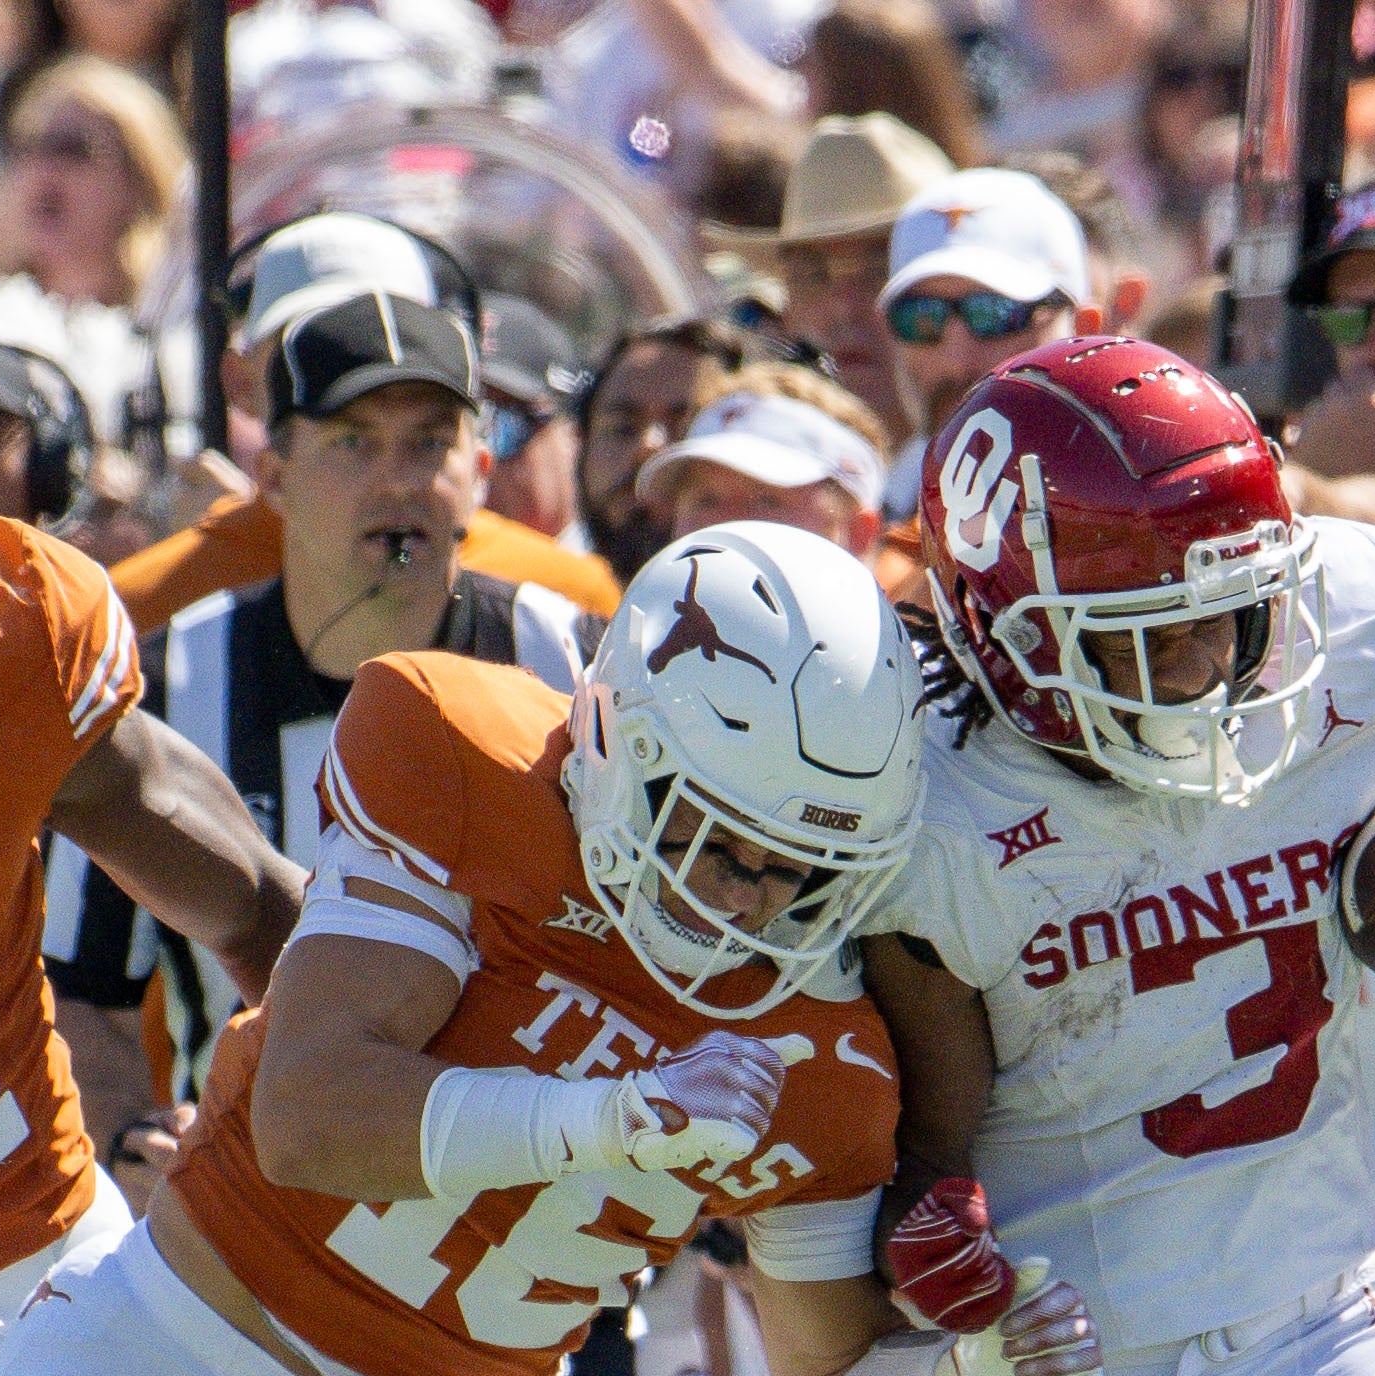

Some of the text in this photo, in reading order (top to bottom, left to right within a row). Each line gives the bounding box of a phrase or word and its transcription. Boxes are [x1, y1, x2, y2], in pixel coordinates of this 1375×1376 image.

[939, 408, 1020, 572] OU
[799, 803, 862, 832] HORNS
[986, 807, 1062, 869] XII
[1022, 823, 1362, 990] SOONER
[511, 971, 815, 1199] TES
[1130, 921, 1334, 1159] 3
